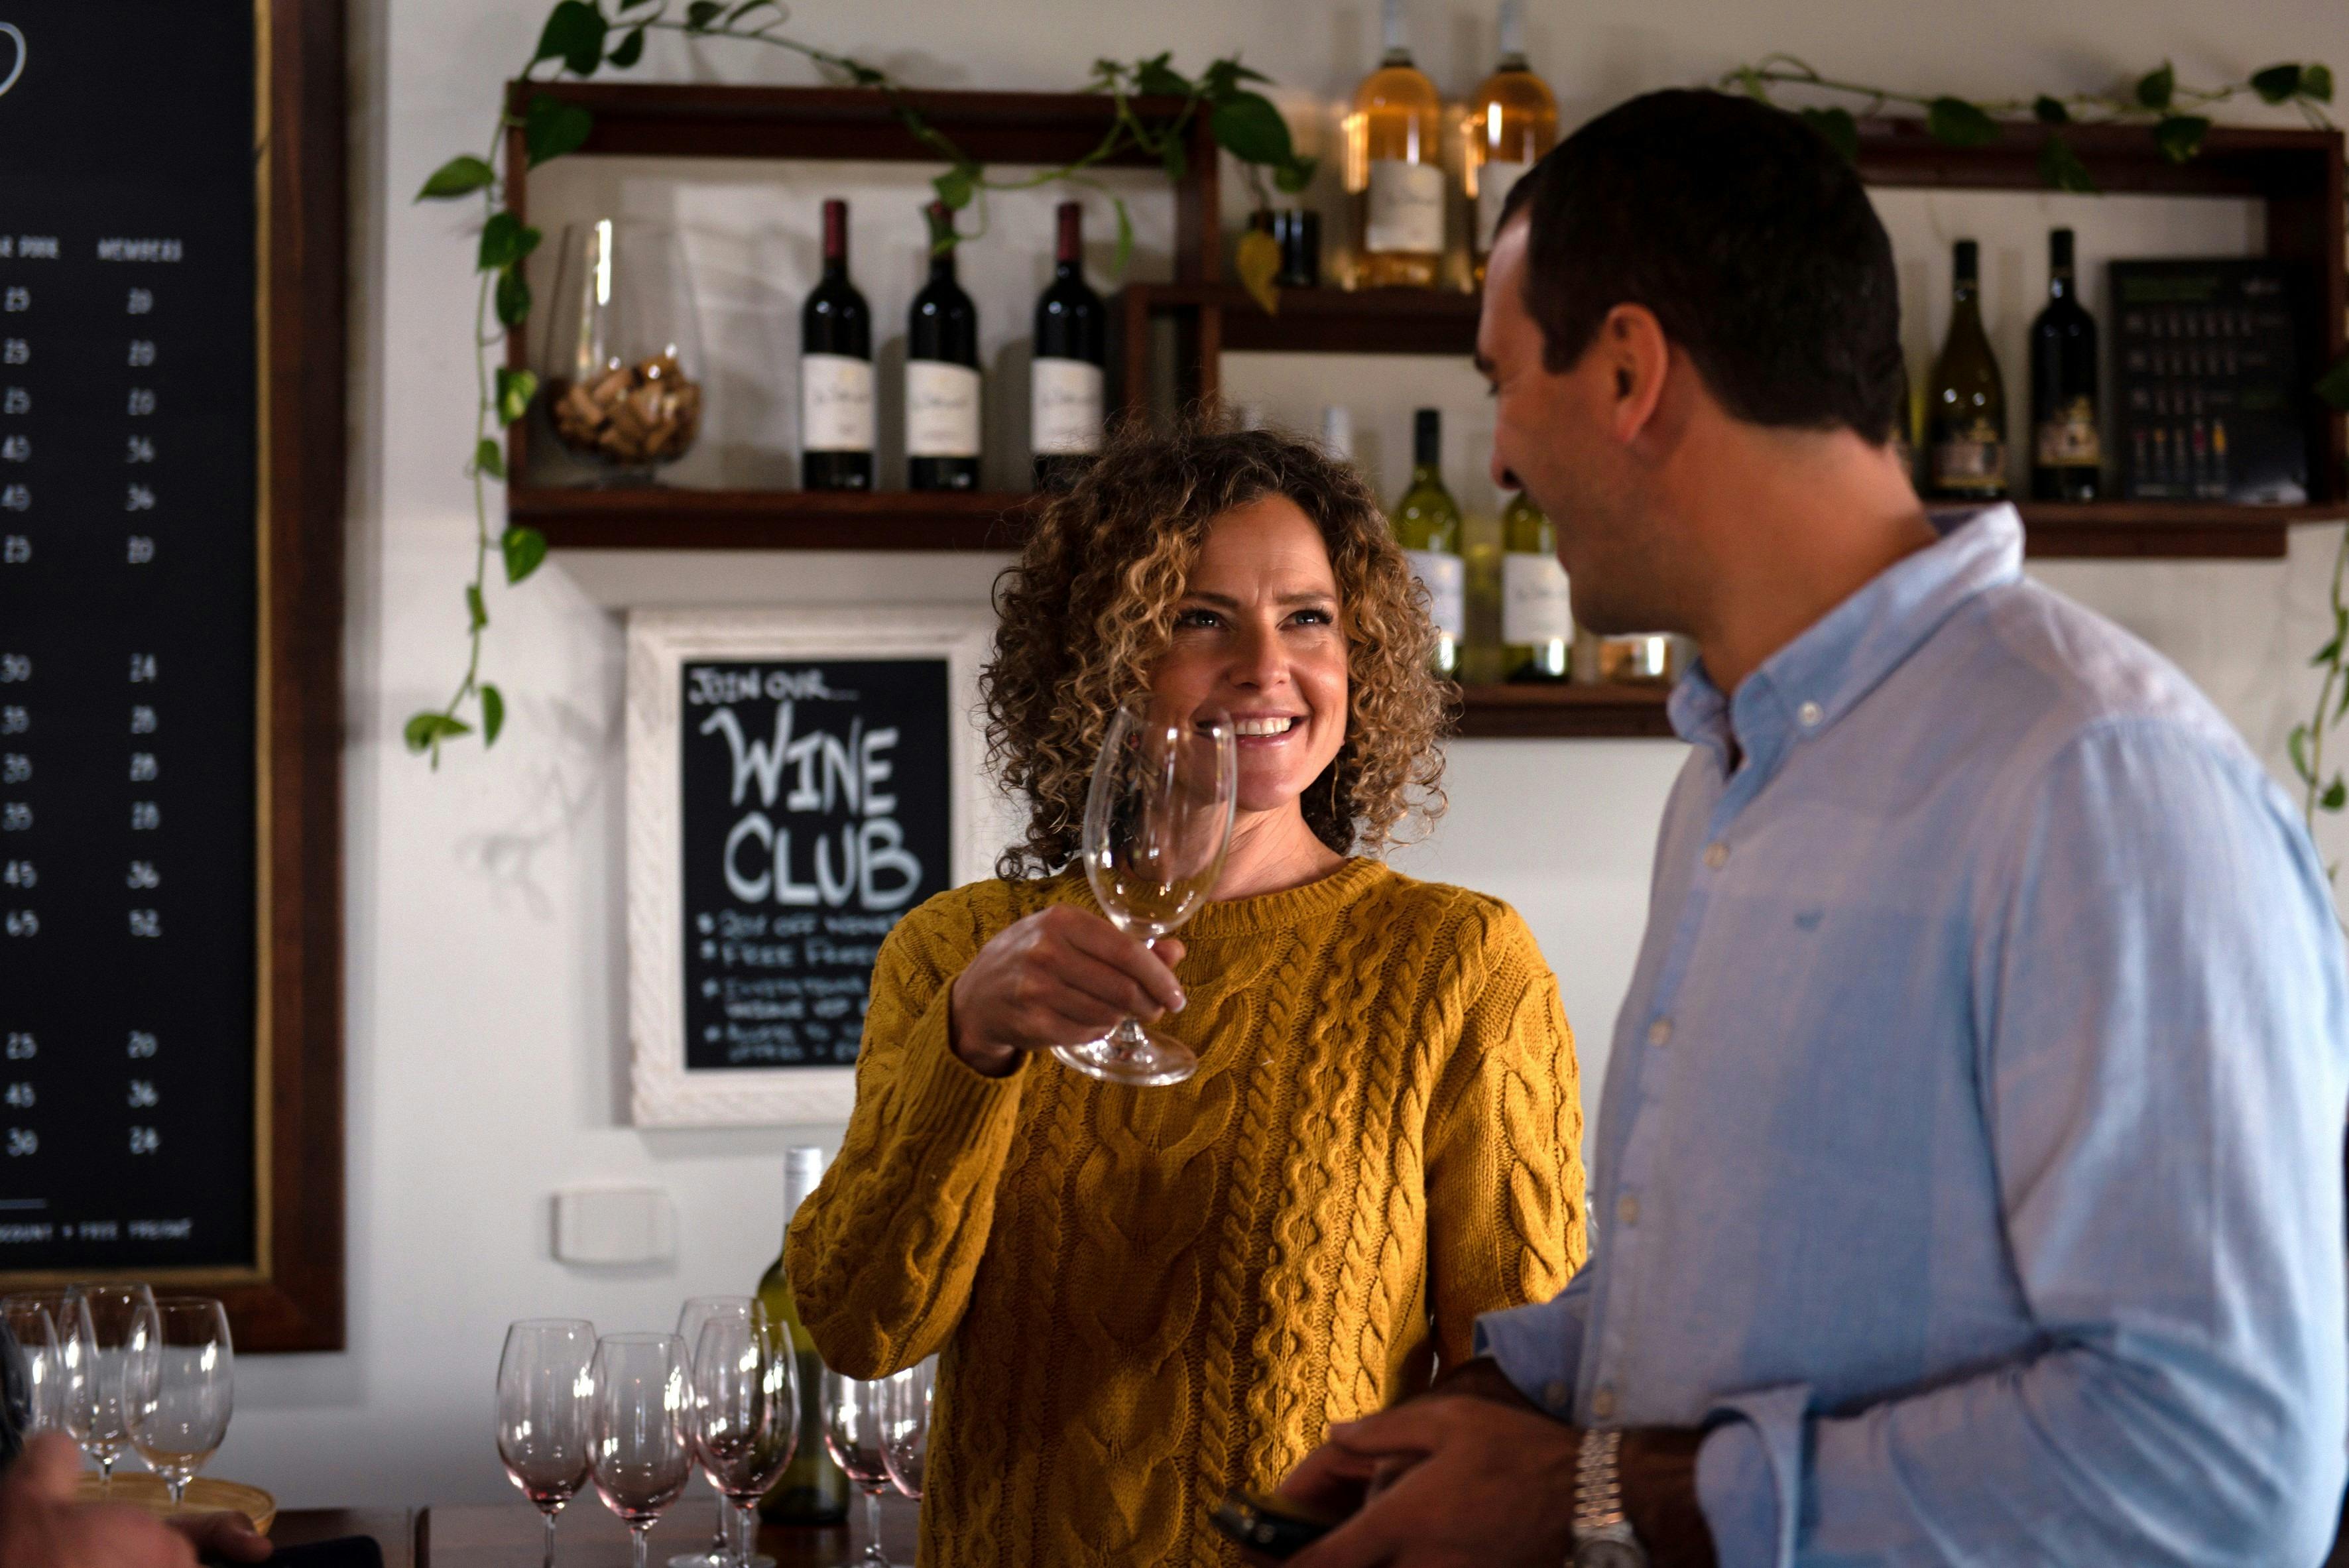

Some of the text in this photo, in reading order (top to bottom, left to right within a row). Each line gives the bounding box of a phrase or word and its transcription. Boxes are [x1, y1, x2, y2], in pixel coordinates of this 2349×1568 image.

[130, 654, 157, 682] 24
[689, 667, 760, 704] JOIN
[700, 700, 899, 817] WINE
[5, 861, 160, 888] 45 36
[724, 810, 923, 911] CLUB
[127, 1030, 157, 1058] 20
[129, 1081, 157, 1107] 36
[9, 1127, 159, 1156] 30 24
